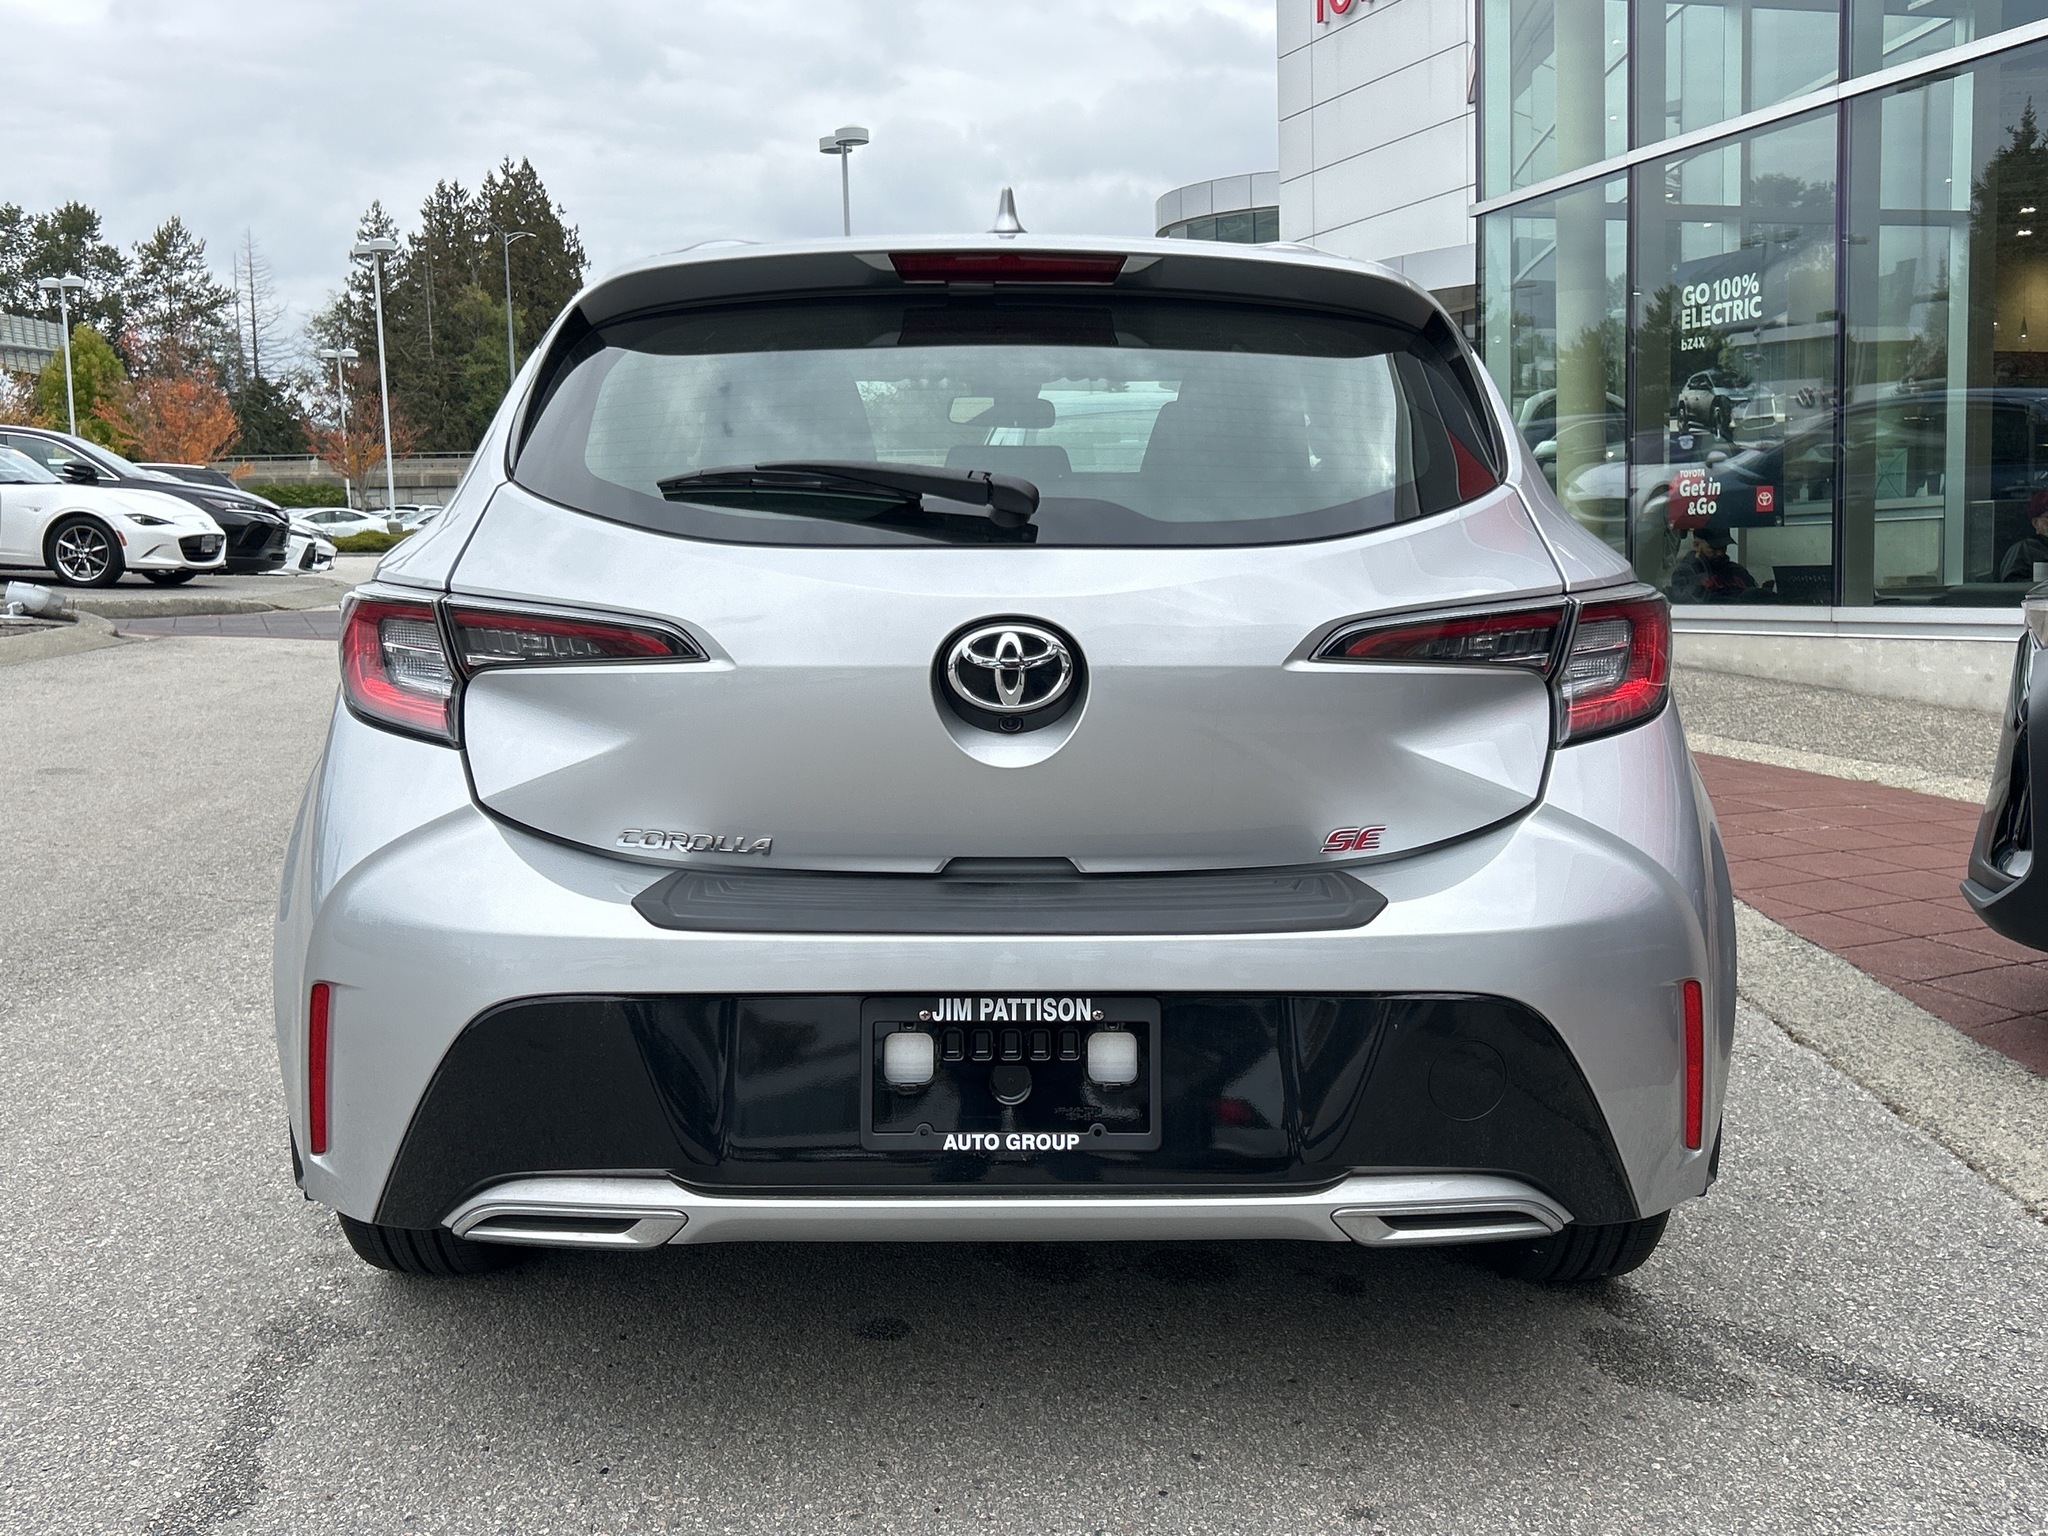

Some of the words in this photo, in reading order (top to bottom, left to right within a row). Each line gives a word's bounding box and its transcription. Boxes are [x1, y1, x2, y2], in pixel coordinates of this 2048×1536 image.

[1682, 283, 1710, 307] GO
[1713, 272, 1760, 301] 100%
[1681, 296, 1762, 330] ELECTRIC
[1681, 336, 1706, 351] bZ4X
[1679, 468, 1706, 478] TOYOTA
[1679, 479, 1706, 497] Get
[1707, 477, 1721, 495] in
[615, 828, 773, 856] COROLLA
[1320, 825, 1387, 854] SE
[932, 998, 973, 1021] JIM
[979, 998, 1092, 1021] PATTISON
[943, 1133, 1000, 1151] AUTO
[1005, 1133, 1080, 1151] GROUP
